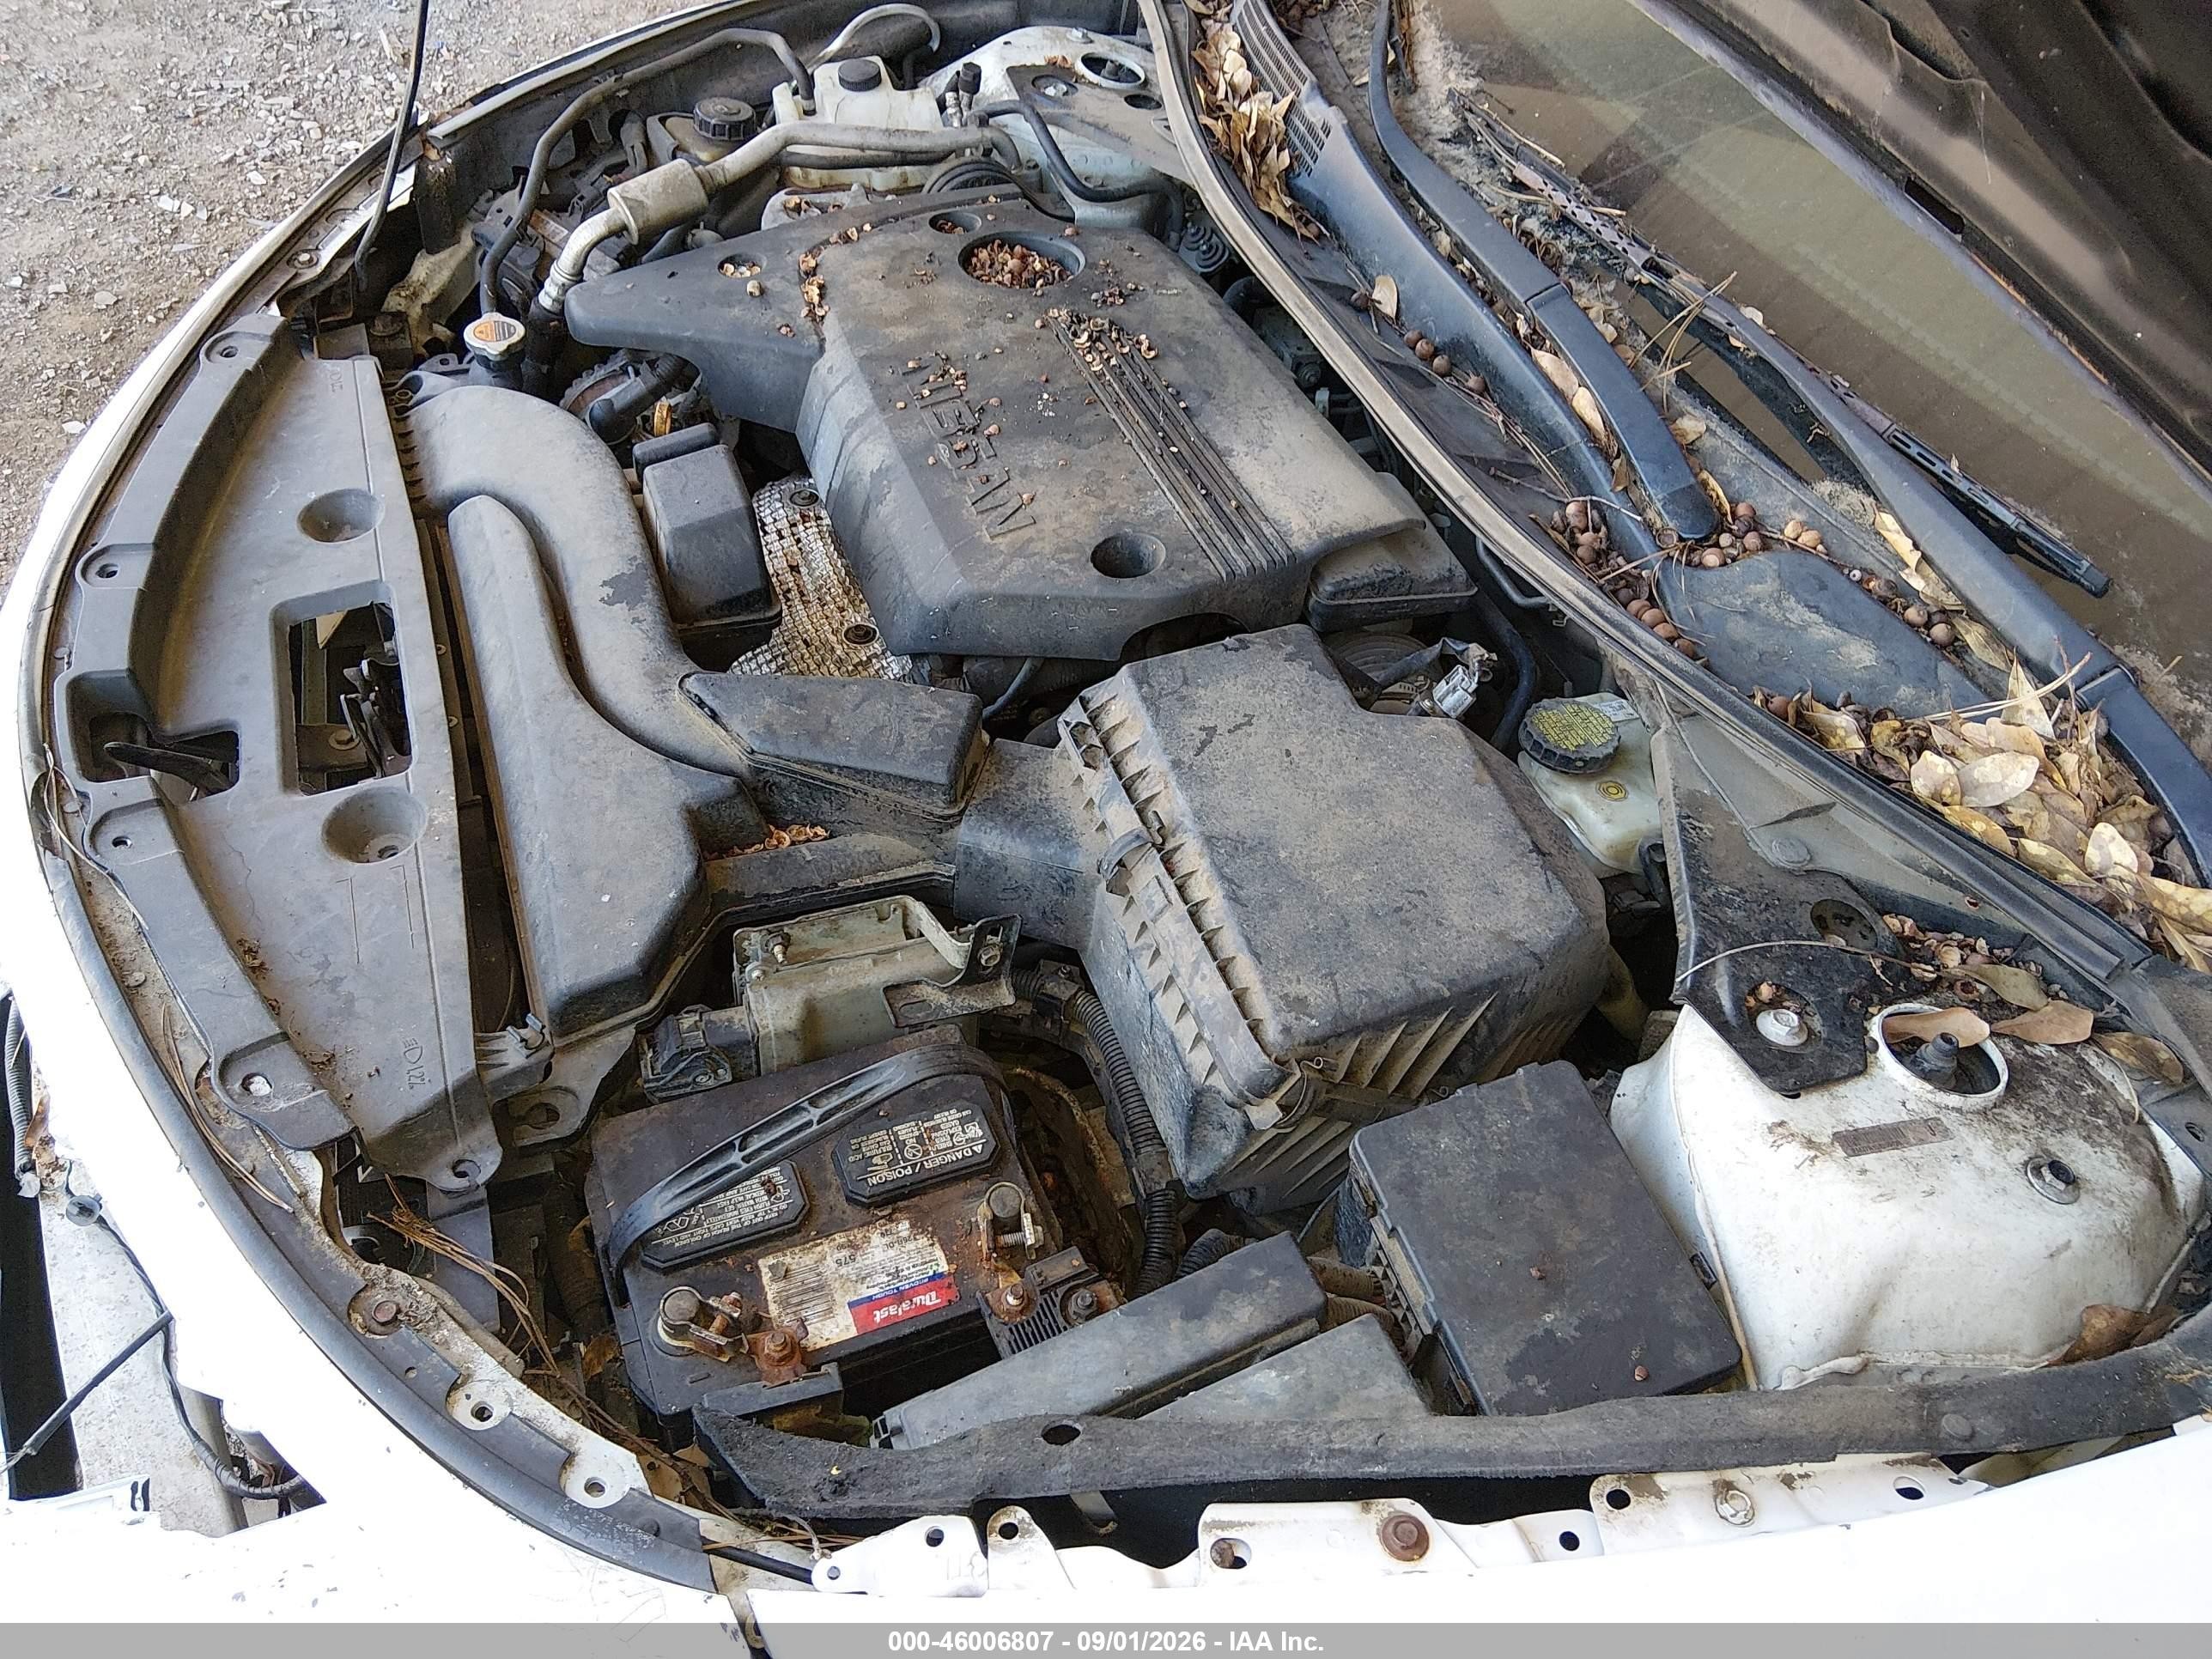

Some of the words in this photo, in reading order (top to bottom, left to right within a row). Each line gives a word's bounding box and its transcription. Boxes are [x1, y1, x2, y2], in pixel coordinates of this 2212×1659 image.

[904, 1136, 916, 1145] NO
[923, 1147, 972, 1169] DANGER
[912, 1162, 922, 1172] /
[866, 1165, 912, 1185] POISON
[834, 1253, 856, 1267] 575
[871, 1287, 897, 1300] TOUGH
[871, 1289, 940, 1323] Duralast
